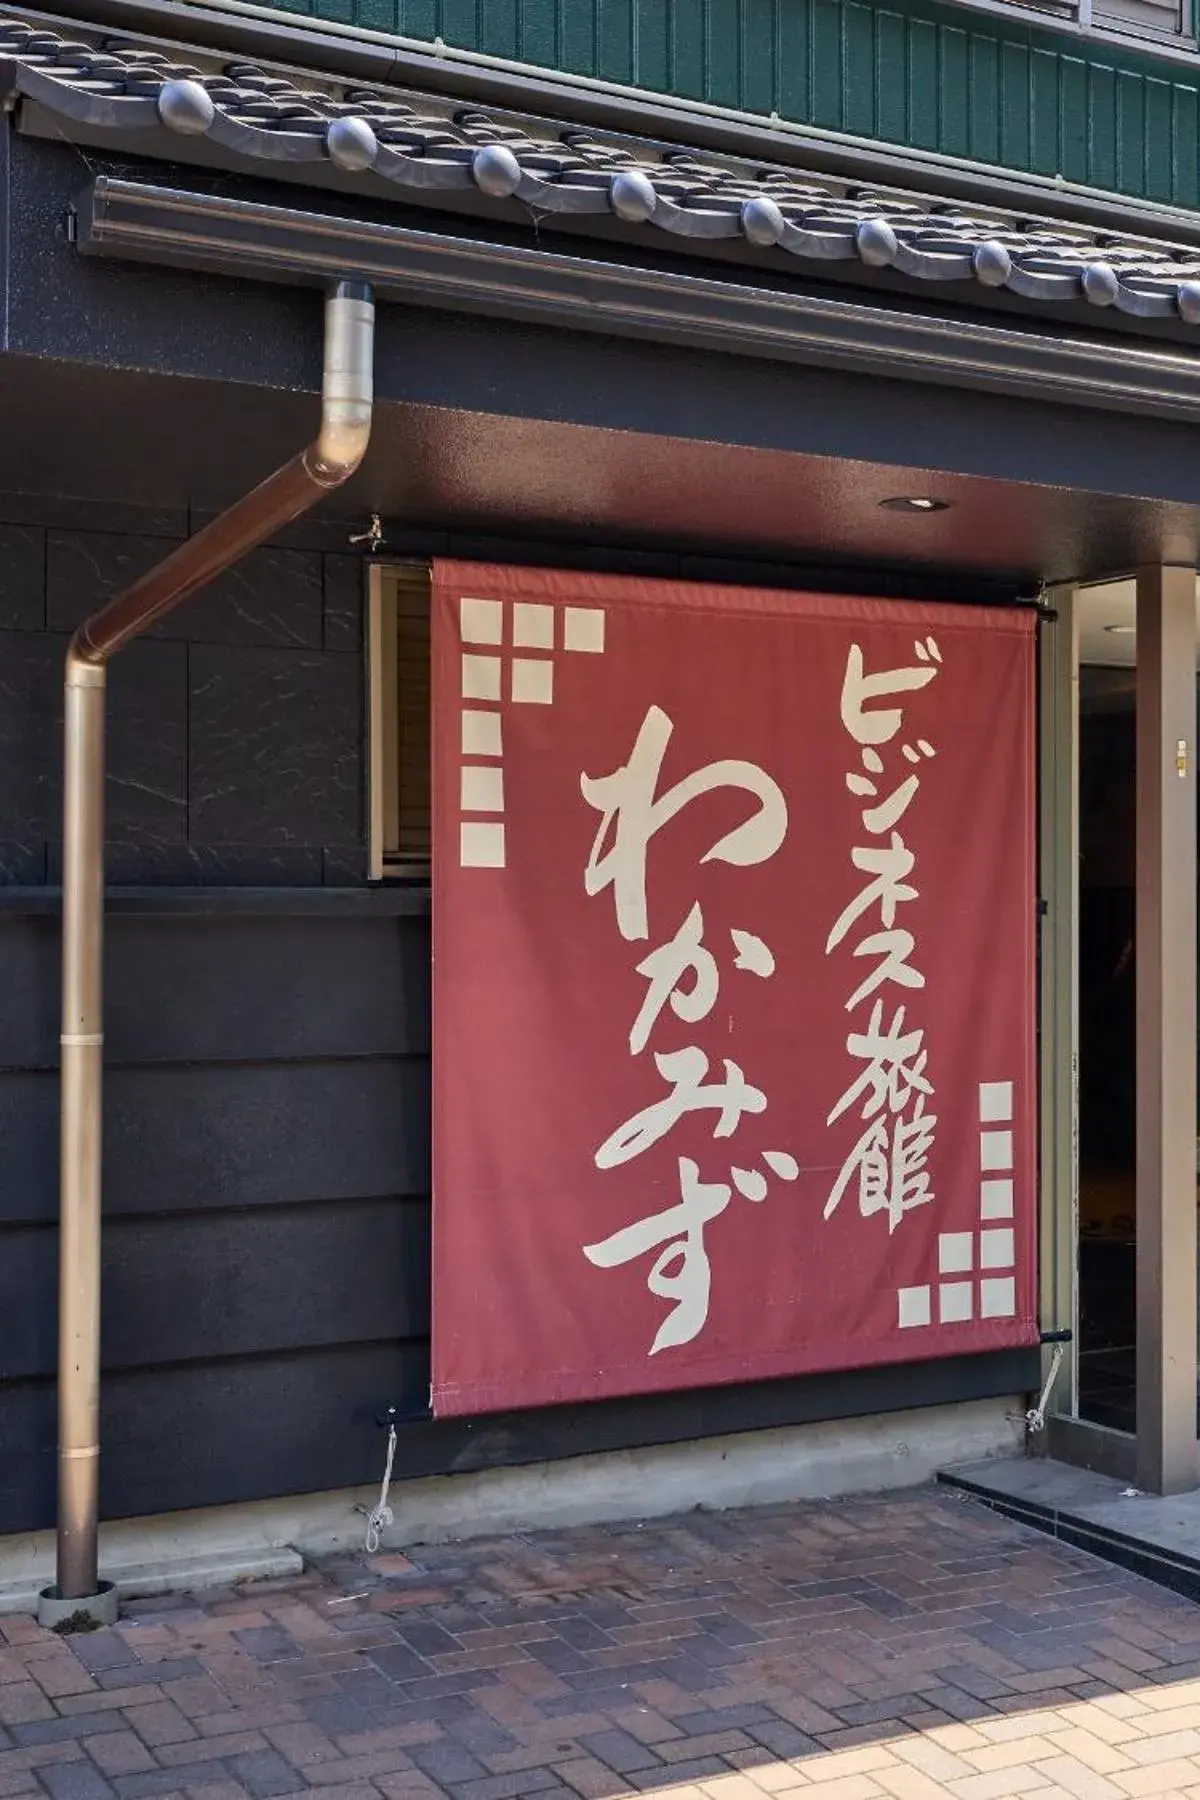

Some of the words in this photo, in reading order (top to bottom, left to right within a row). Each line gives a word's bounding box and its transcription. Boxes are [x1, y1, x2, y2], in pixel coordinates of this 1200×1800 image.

[581, 705, 798, 1356] わかみず
[824, 636, 943, 1234] ビジネス旅館
